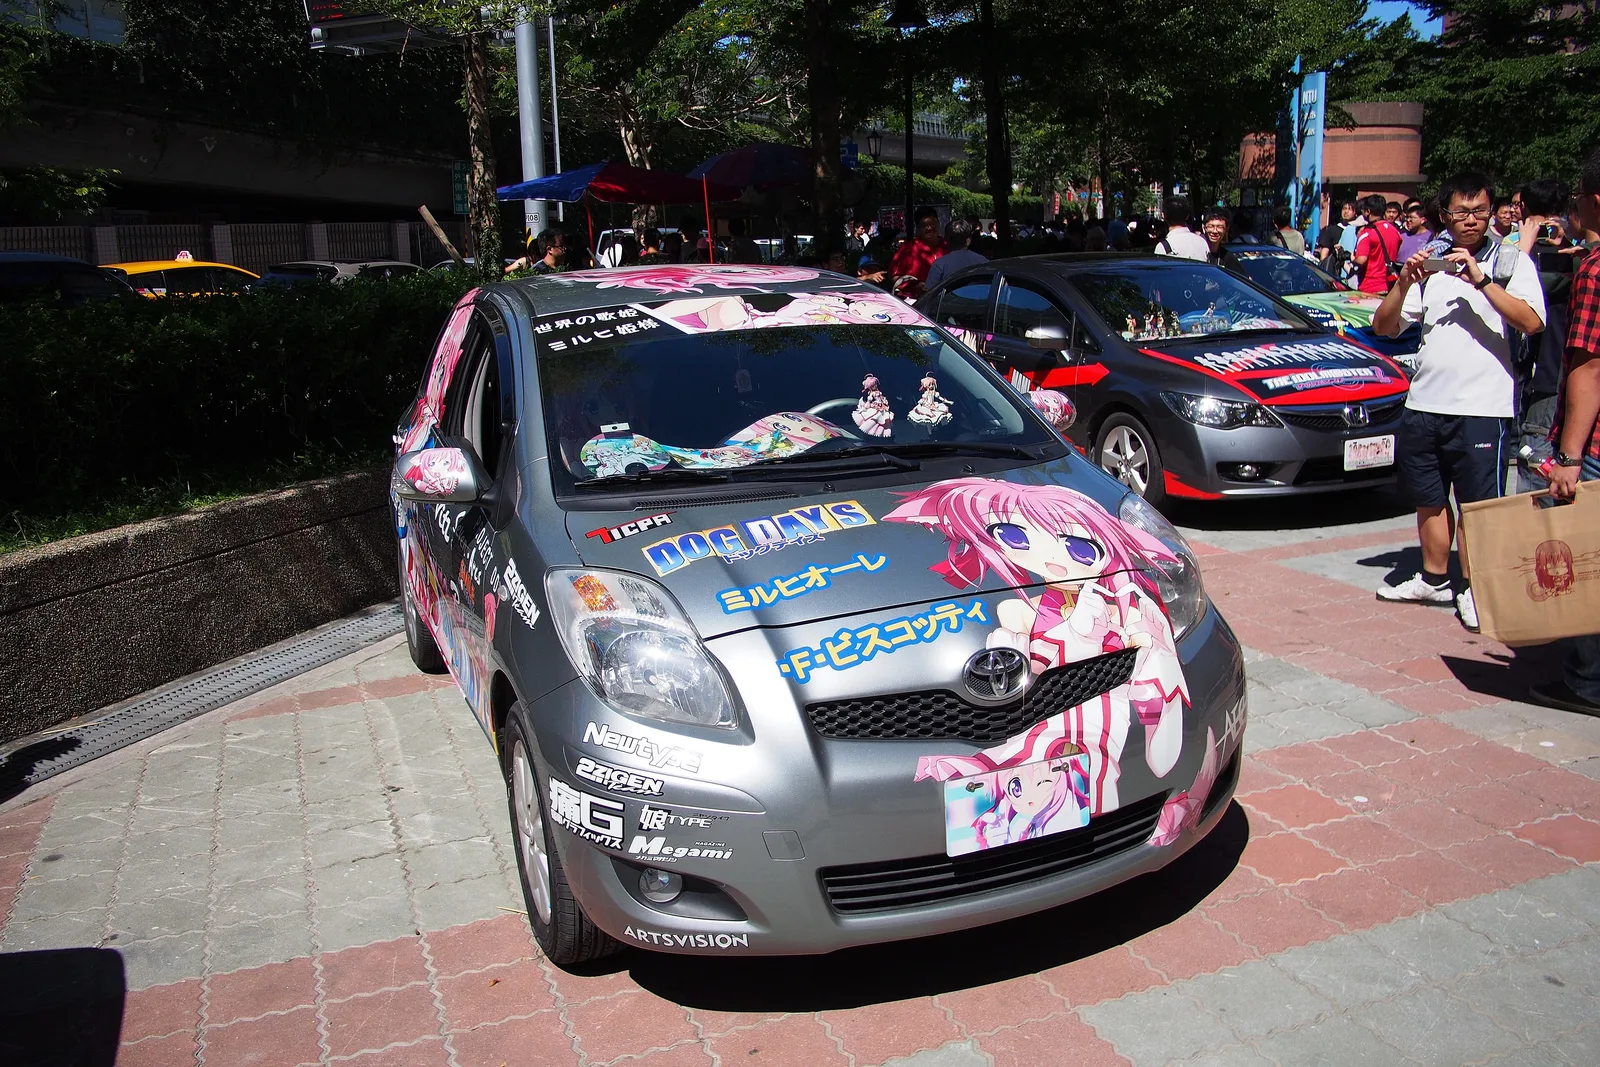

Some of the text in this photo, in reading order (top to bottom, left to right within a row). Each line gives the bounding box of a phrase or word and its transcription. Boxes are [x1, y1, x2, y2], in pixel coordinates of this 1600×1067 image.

[1302, 88, 1317, 105] NTU
[533, 308, 639, 334] 世界の歌姫
[547, 318, 660, 351] ミルヒ姫様
[585, 511, 677, 544] TICPA
[643, 501, 871, 575] DOG DAYS
[718, 554, 888, 612] ミルヒオーレ
[582, 720, 703, 774] Newtype
[628, 835, 733, 860] Megami
[624, 925, 749, 949] ARTSVISION
